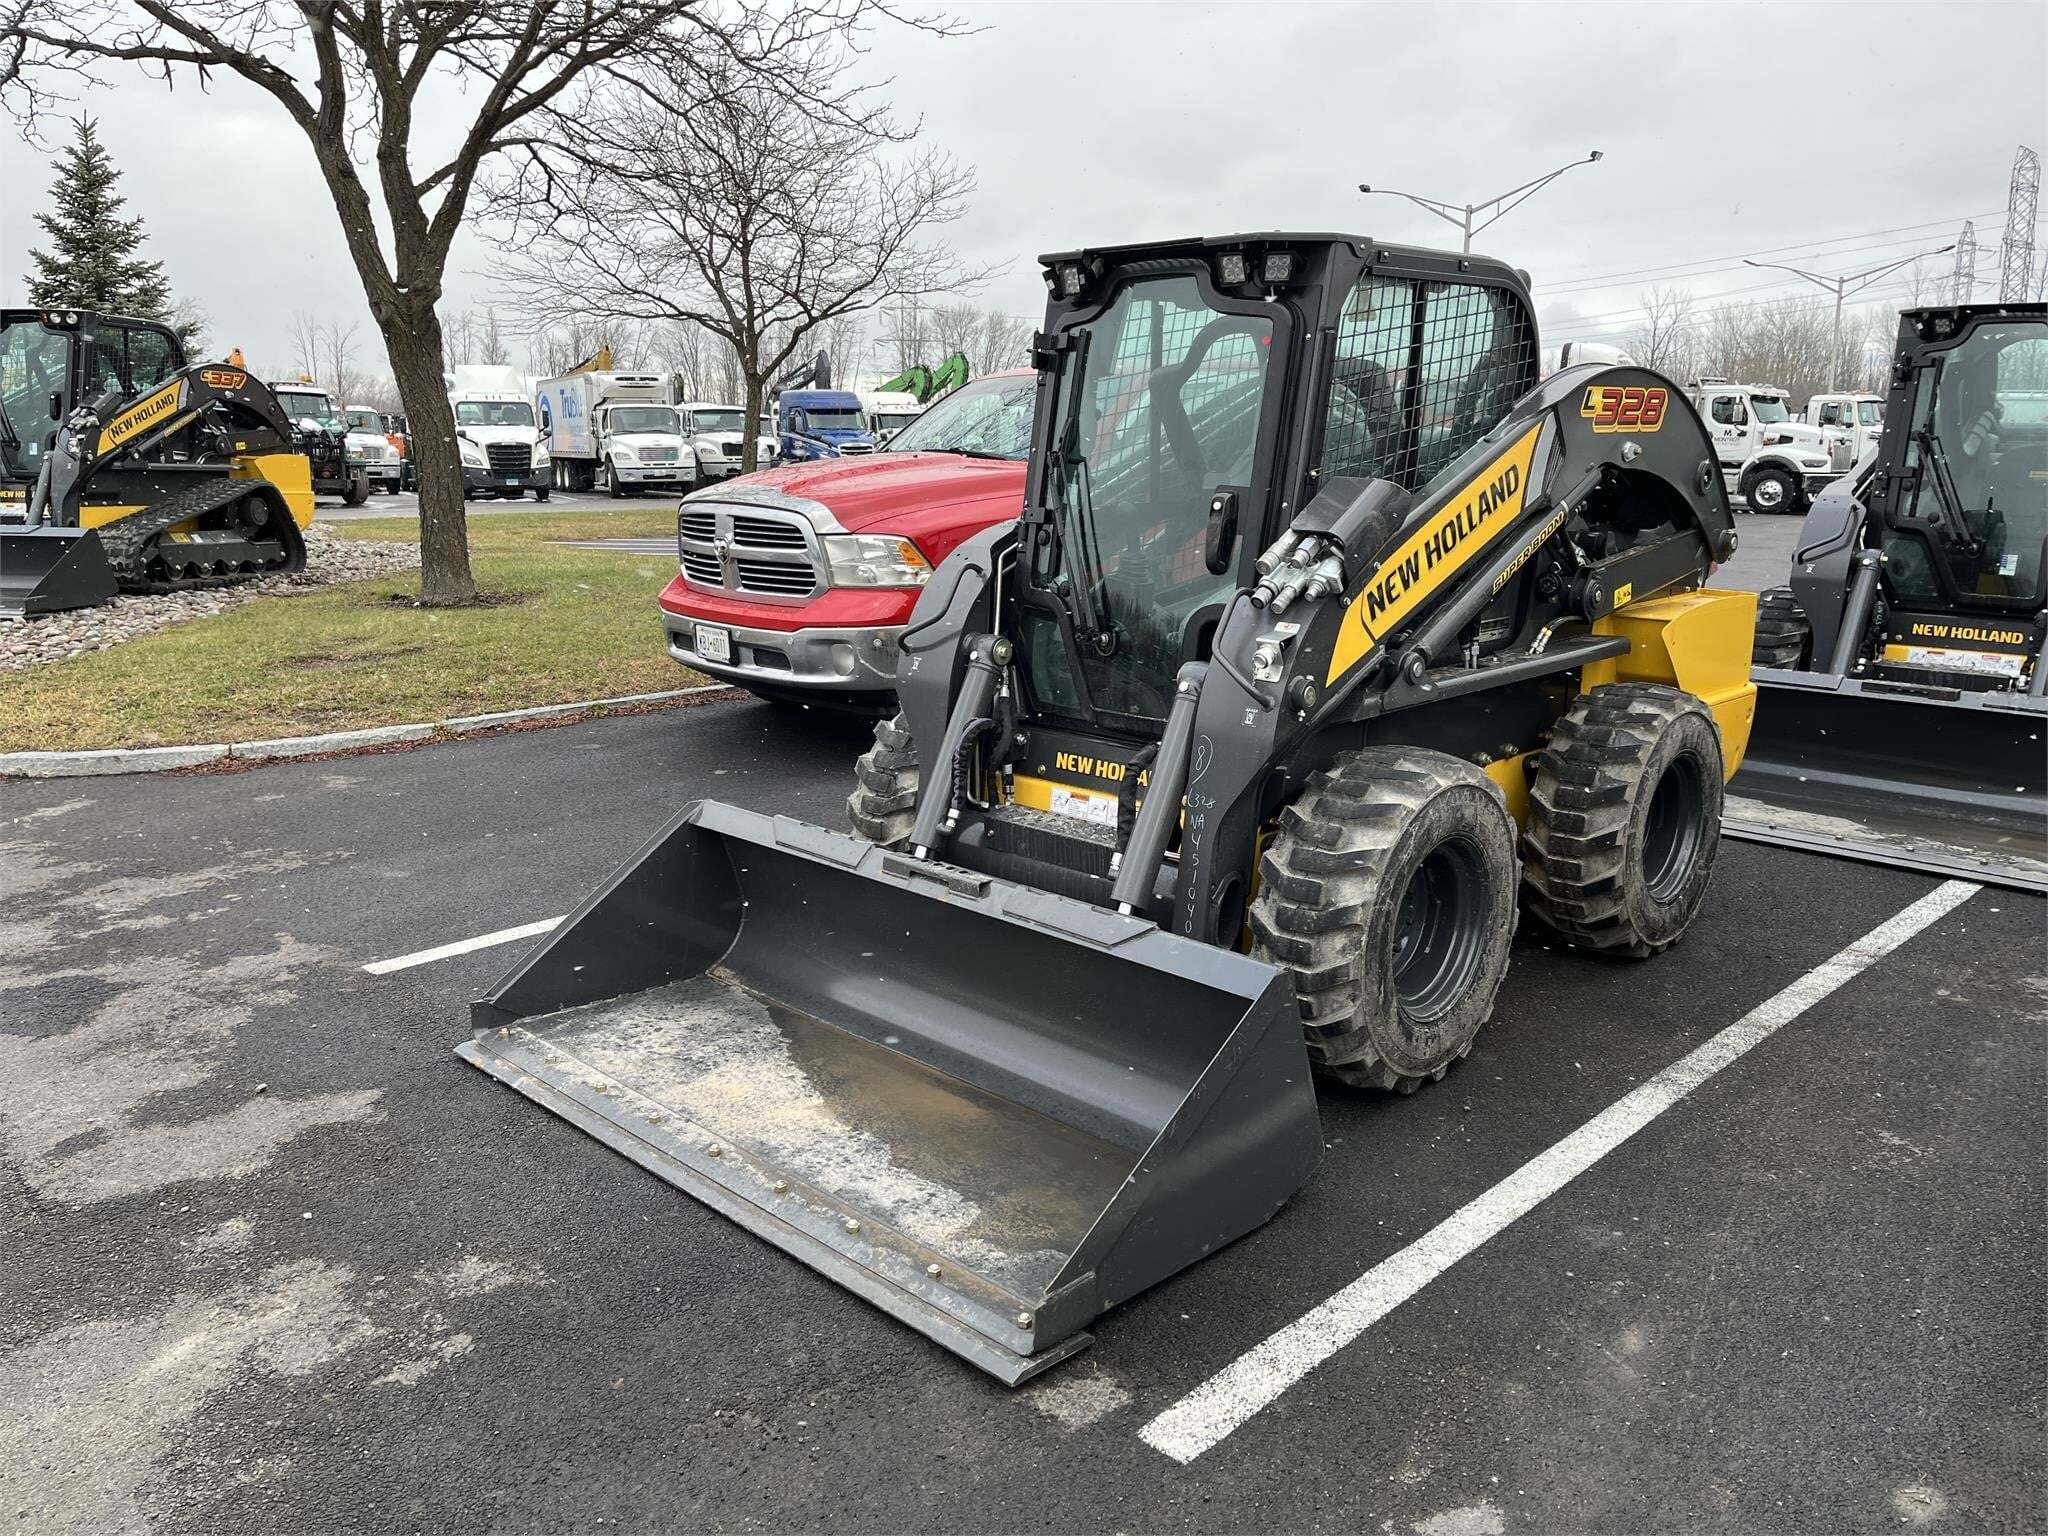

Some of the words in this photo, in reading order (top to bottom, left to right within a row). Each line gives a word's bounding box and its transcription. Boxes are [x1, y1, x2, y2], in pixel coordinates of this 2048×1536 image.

[111, 417, 133, 438] NEW
[134, 393, 175, 425] HOLLAND
[1580, 386, 1668, 433] L328
[1366, 550, 1420, 622] NEW
[1424, 463, 1520, 571] HOLLAND
[1493, 545, 1532, 595] SUPER
[1531, 510, 1564, 553] BOOM
[1912, 623, 1949, 638] NEW
[1951, 626, 2024, 645] HOLLAND
[1055, 751, 1094, 775] NEW
